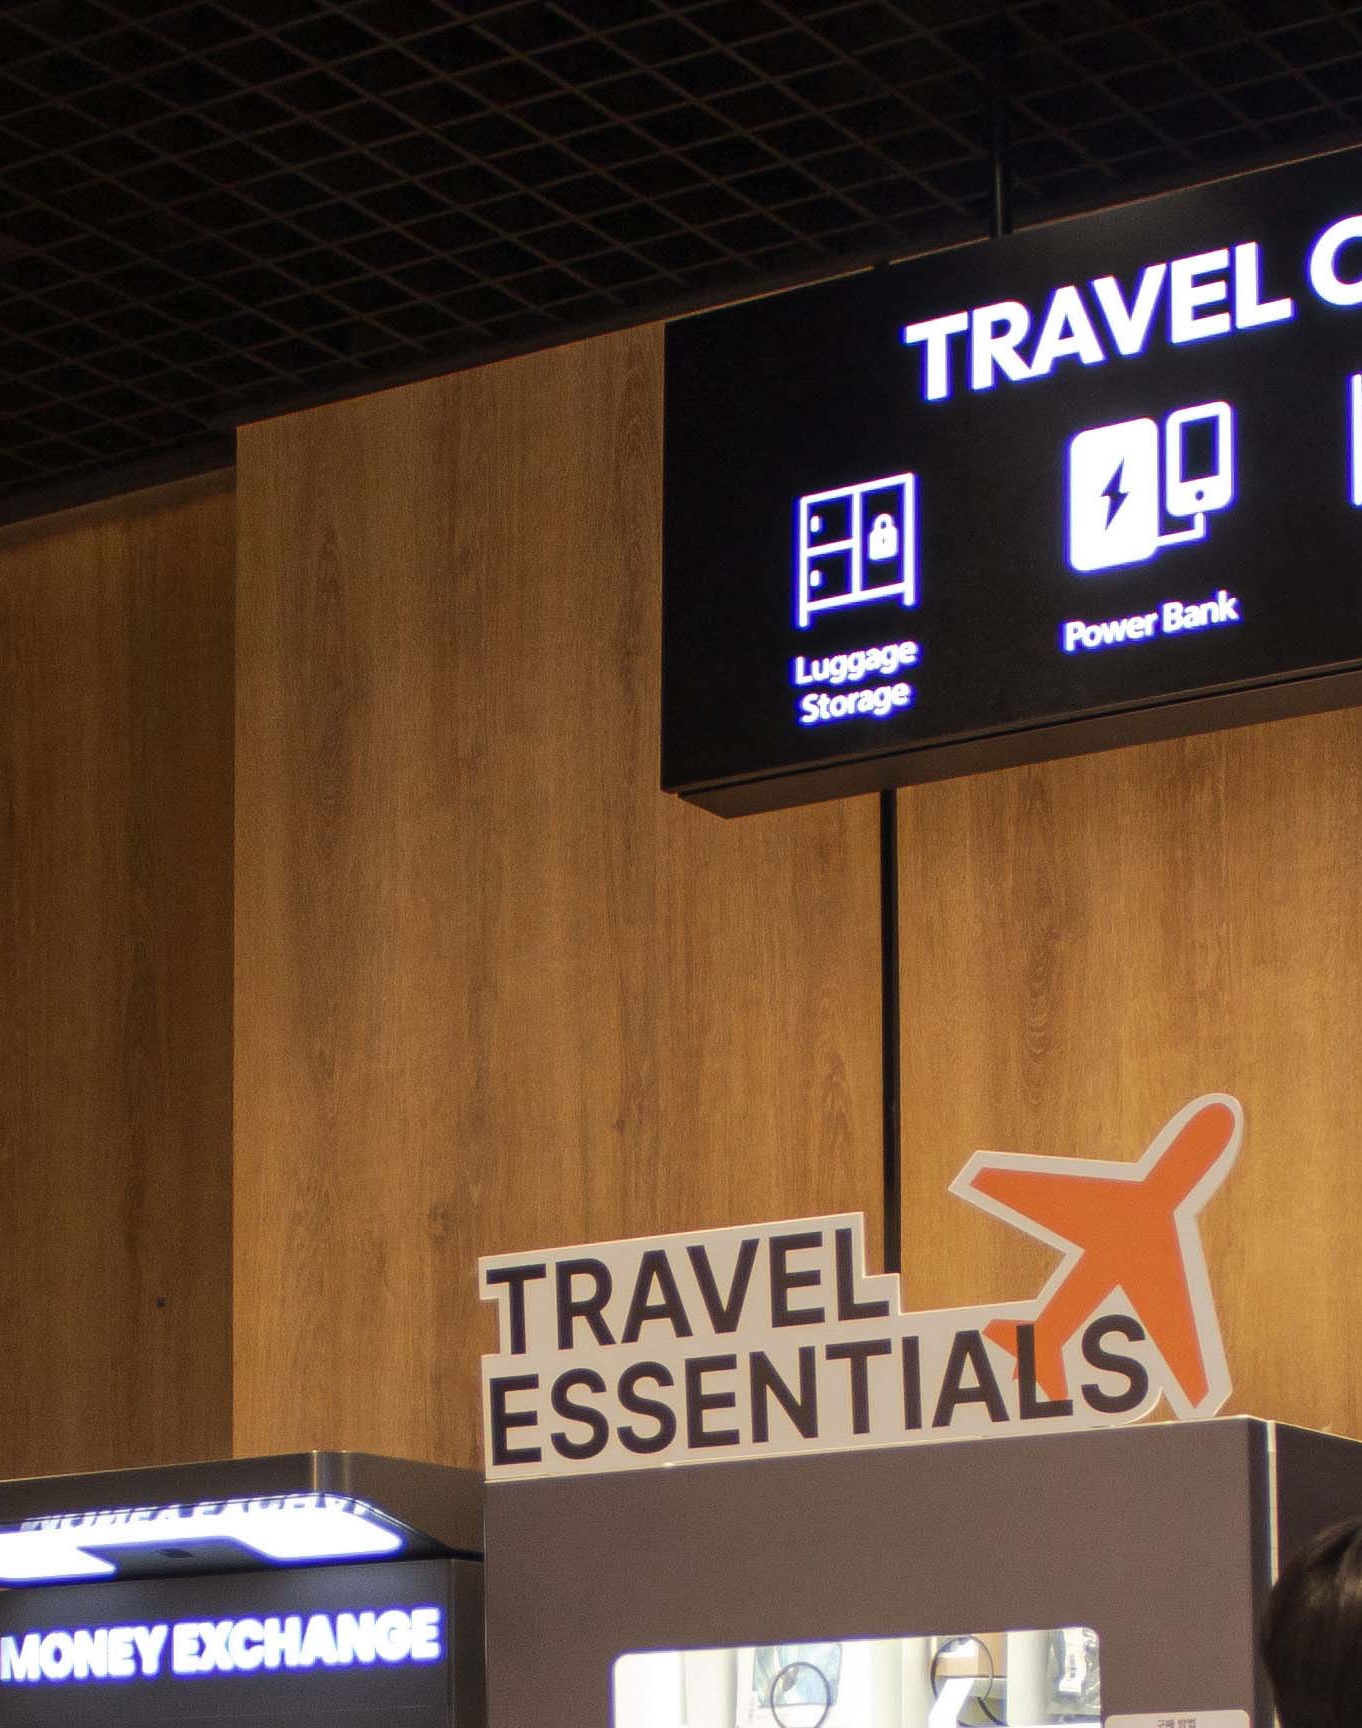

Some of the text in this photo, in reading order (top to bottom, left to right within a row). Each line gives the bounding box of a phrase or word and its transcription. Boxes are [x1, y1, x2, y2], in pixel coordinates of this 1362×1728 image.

[903, 240, 1293, 403] TRAVEL
[1063, 590, 1239, 653] Power Bank
[795, 637, 918, 690] Luggage
[799, 678, 911, 727] Storage
[485, 1227, 890, 1355] TRAVEL
[490, 1314, 1150, 1468] ESSENTIALS
[0, 1607, 442, 1684] MONEY EXCHANGE
